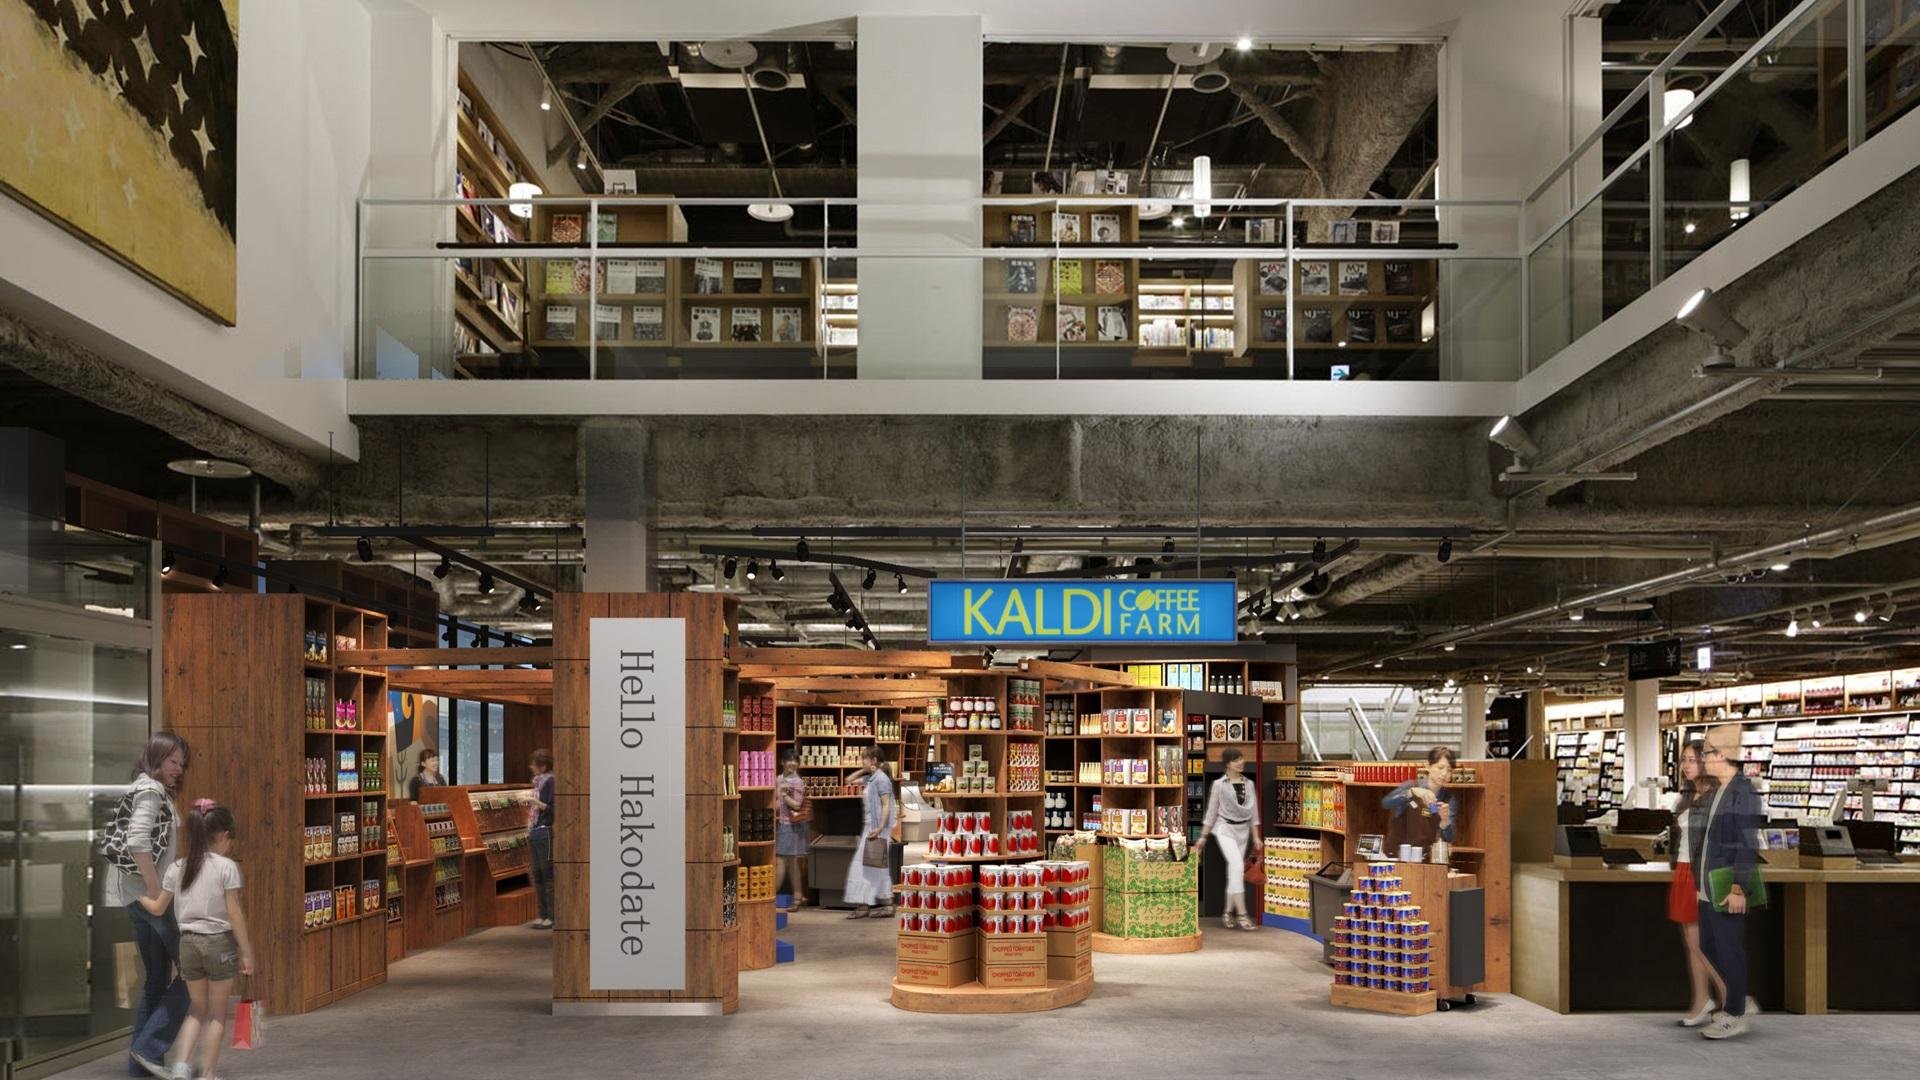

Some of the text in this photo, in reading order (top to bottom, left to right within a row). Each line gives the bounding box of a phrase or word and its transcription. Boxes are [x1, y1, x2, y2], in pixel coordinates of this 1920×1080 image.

[964, 588, 1111, 635] KALDI
[1119, 589, 1200, 611] COFFEE
[1120, 613, 1200, 635] FARM
[620, 650, 655, 955] Hello Hakodate
